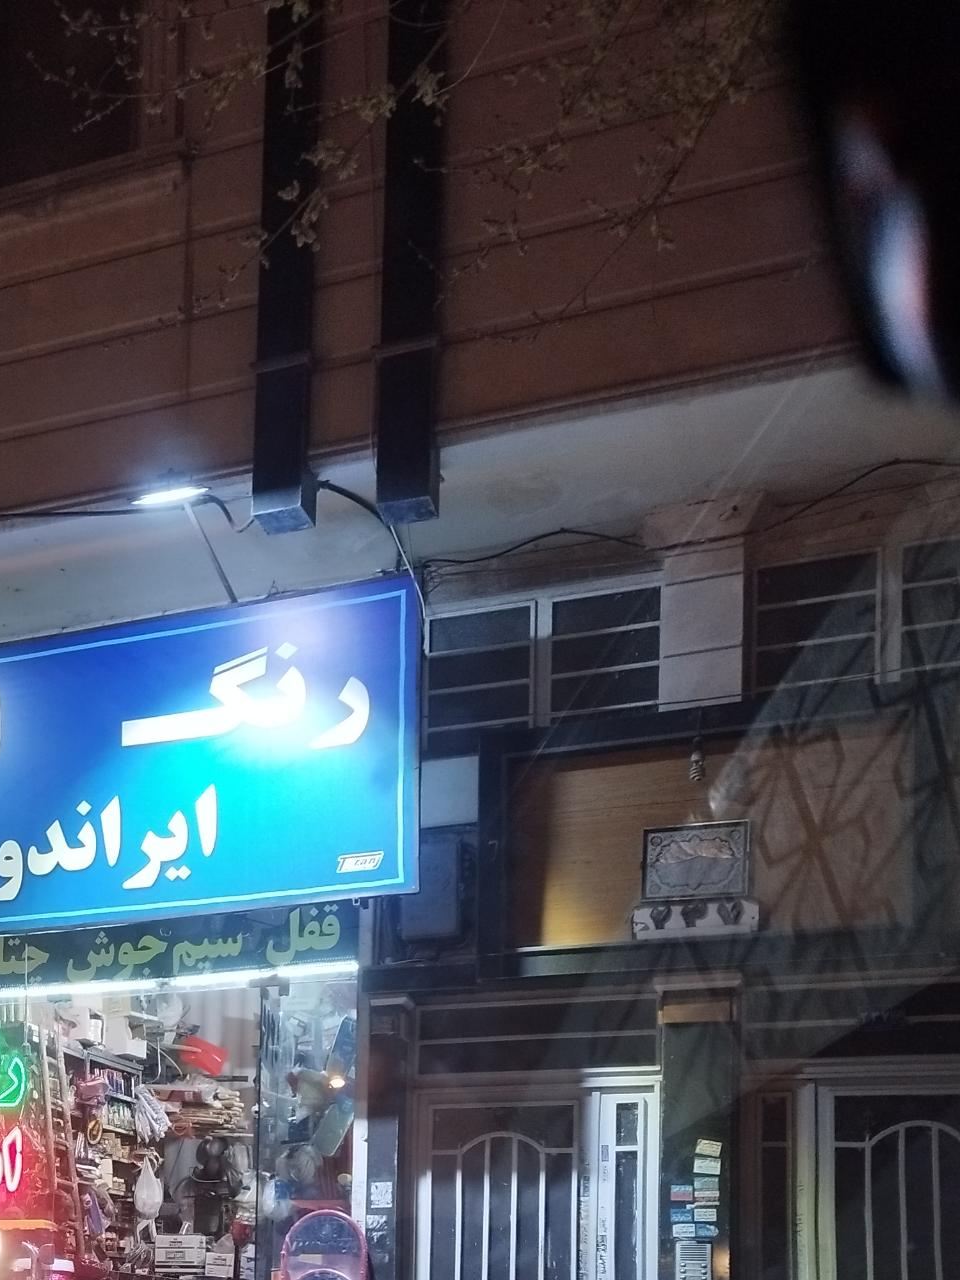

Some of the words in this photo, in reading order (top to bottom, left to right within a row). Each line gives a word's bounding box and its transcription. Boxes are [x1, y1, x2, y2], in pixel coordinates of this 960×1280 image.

[121, 642, 370, 750] رنگ
[66, 931, 169, 982] جوش
[172, 932, 244, 976] سیم
[266, 903, 341, 966] قفل
